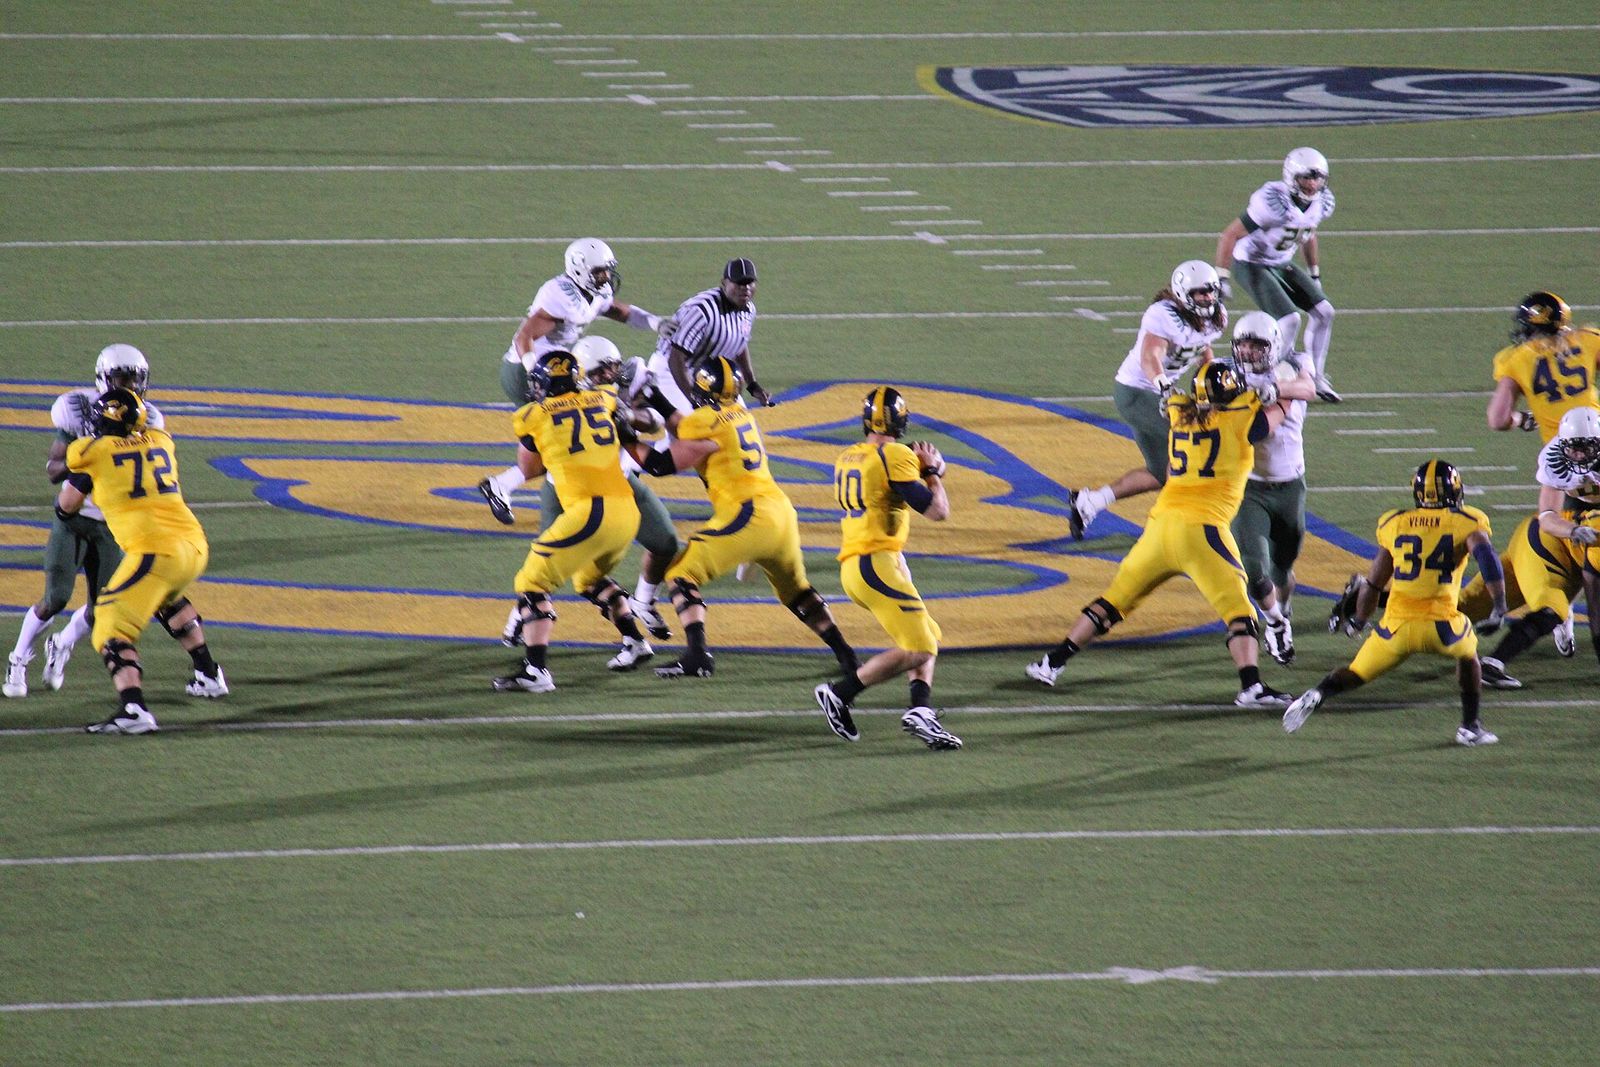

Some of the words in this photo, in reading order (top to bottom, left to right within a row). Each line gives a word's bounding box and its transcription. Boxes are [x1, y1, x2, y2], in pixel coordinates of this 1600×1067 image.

[1532, 347, 1588, 402] 45
[551, 406, 615, 454] 75
[1168, 428, 1221, 478] 57
[112, 447, 178, 498] 72
[837, 469, 867, 518] 10
[1394, 534, 1456, 584] 34
